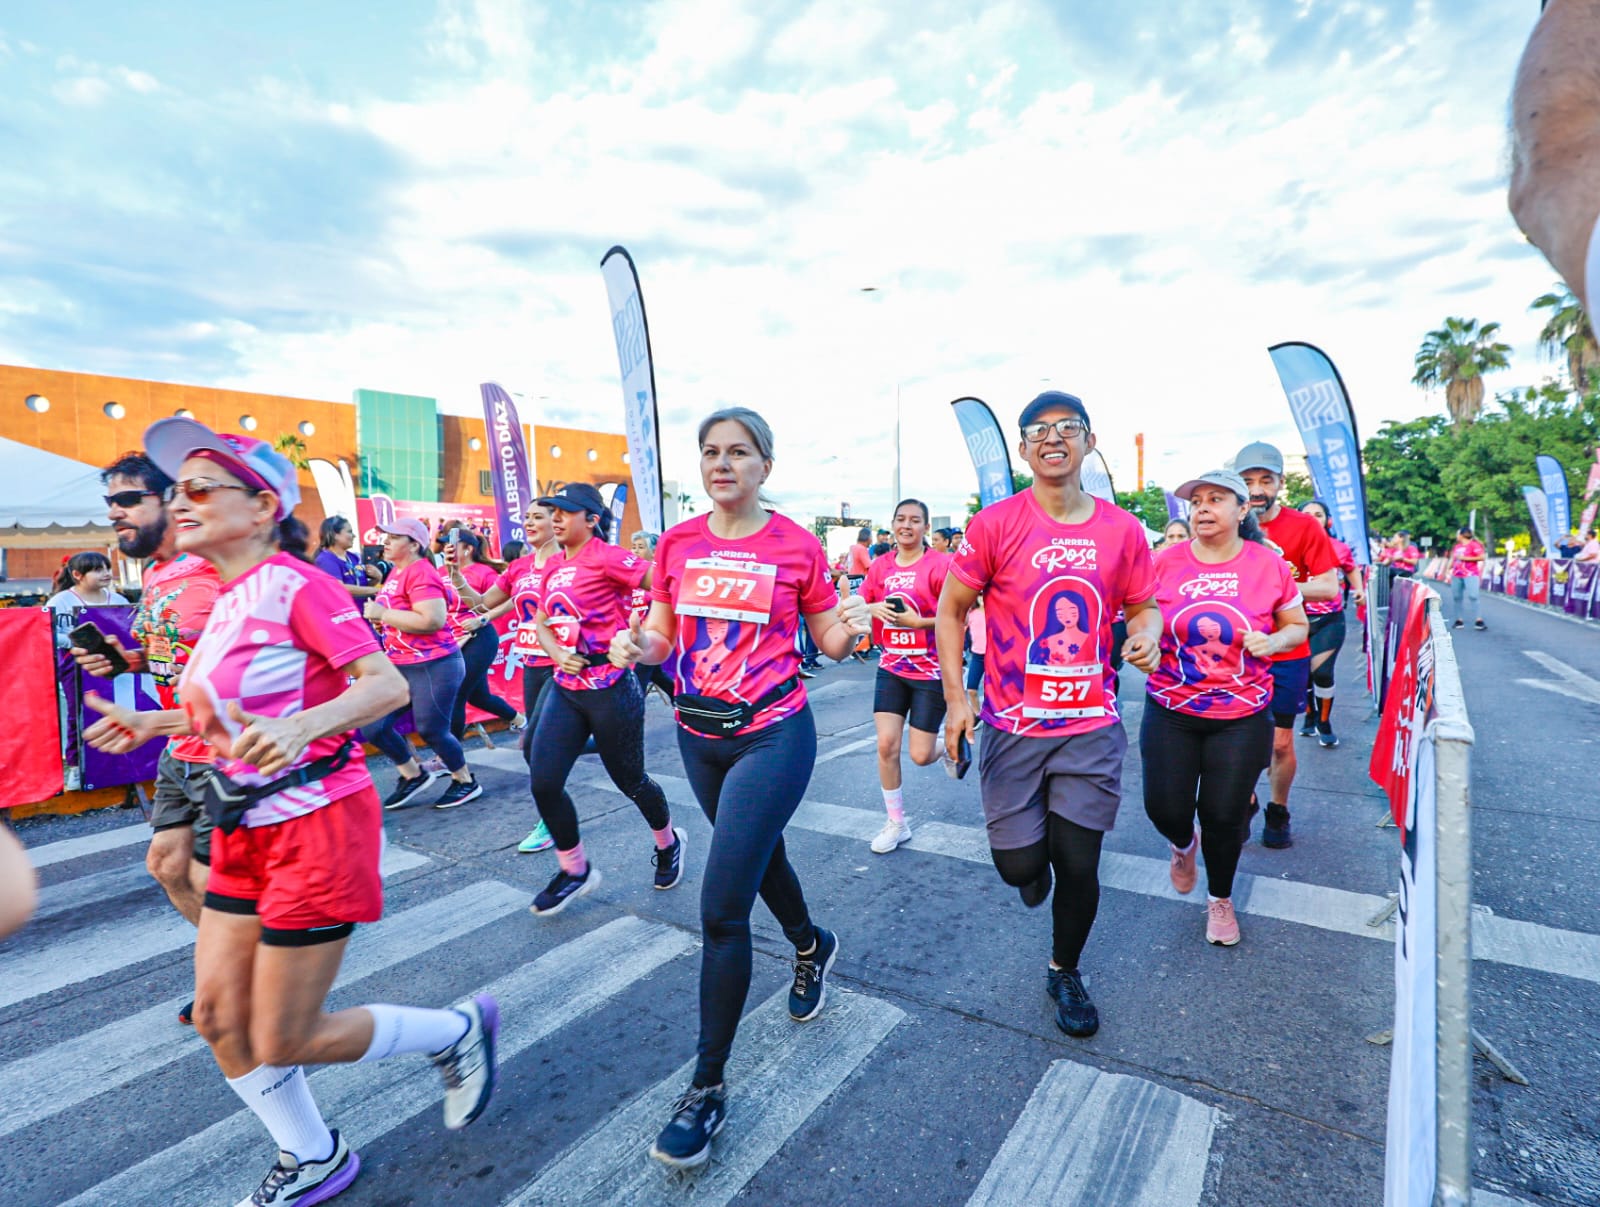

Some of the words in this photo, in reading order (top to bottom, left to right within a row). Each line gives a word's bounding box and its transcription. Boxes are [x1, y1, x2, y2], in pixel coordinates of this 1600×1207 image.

[494, 400, 512, 443] DÍAZ
[501, 448, 523, 525] ALBERTO
[1051, 538, 1097, 546] CARRERA
[710, 550, 757, 560] CARRERA
[1031, 545, 1097, 573] Rosa
[695, 574, 757, 601] 977
[1178, 578, 1240, 600] Rosa
[519, 631, 541, 646] 00
[890, 631, 916, 645] 581
[1040, 680, 1092, 702] 527
